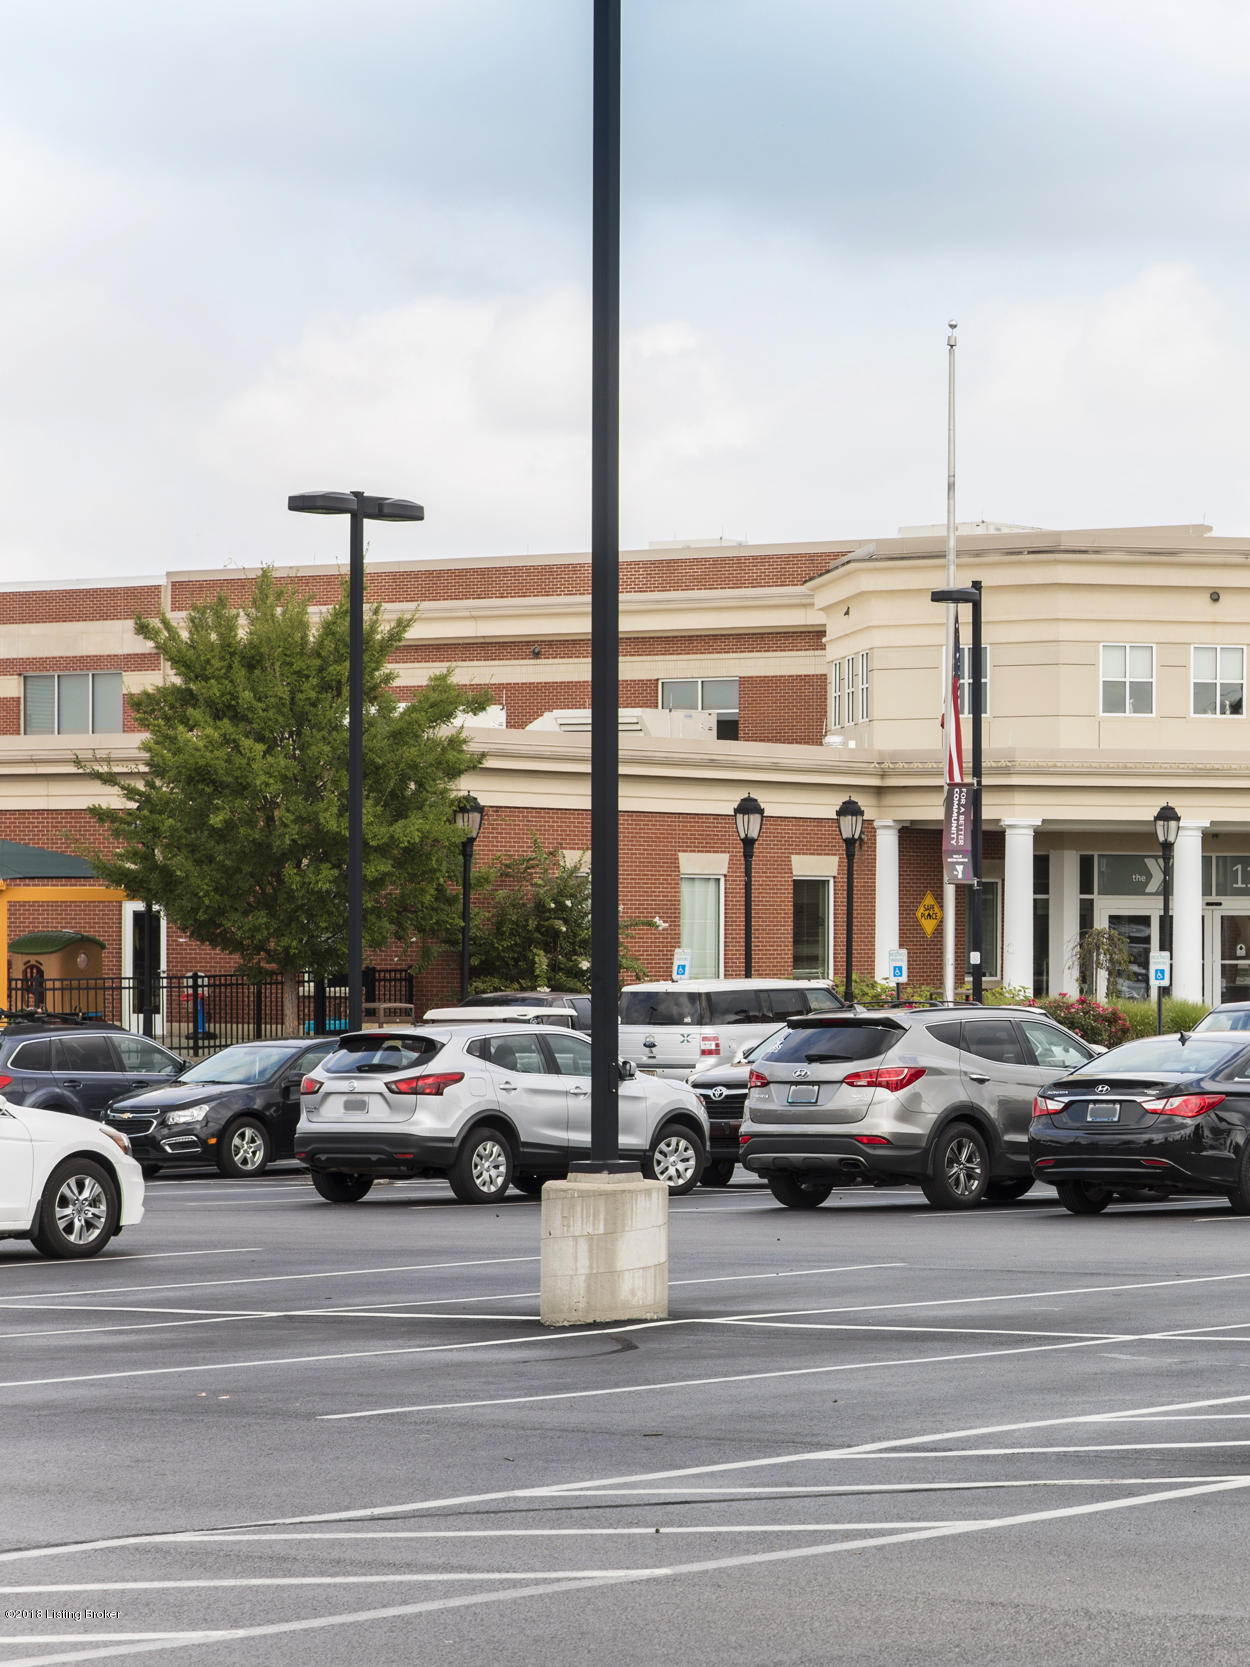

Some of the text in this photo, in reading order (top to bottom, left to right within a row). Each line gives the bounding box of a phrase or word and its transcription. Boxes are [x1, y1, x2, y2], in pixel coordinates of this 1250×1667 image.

[950, 788, 960, 846] COMMUNITY
[958, 815, 966, 846] BETTER
[1132, 873, 1146, 882] the
[920, 912, 938, 920] PLACE
